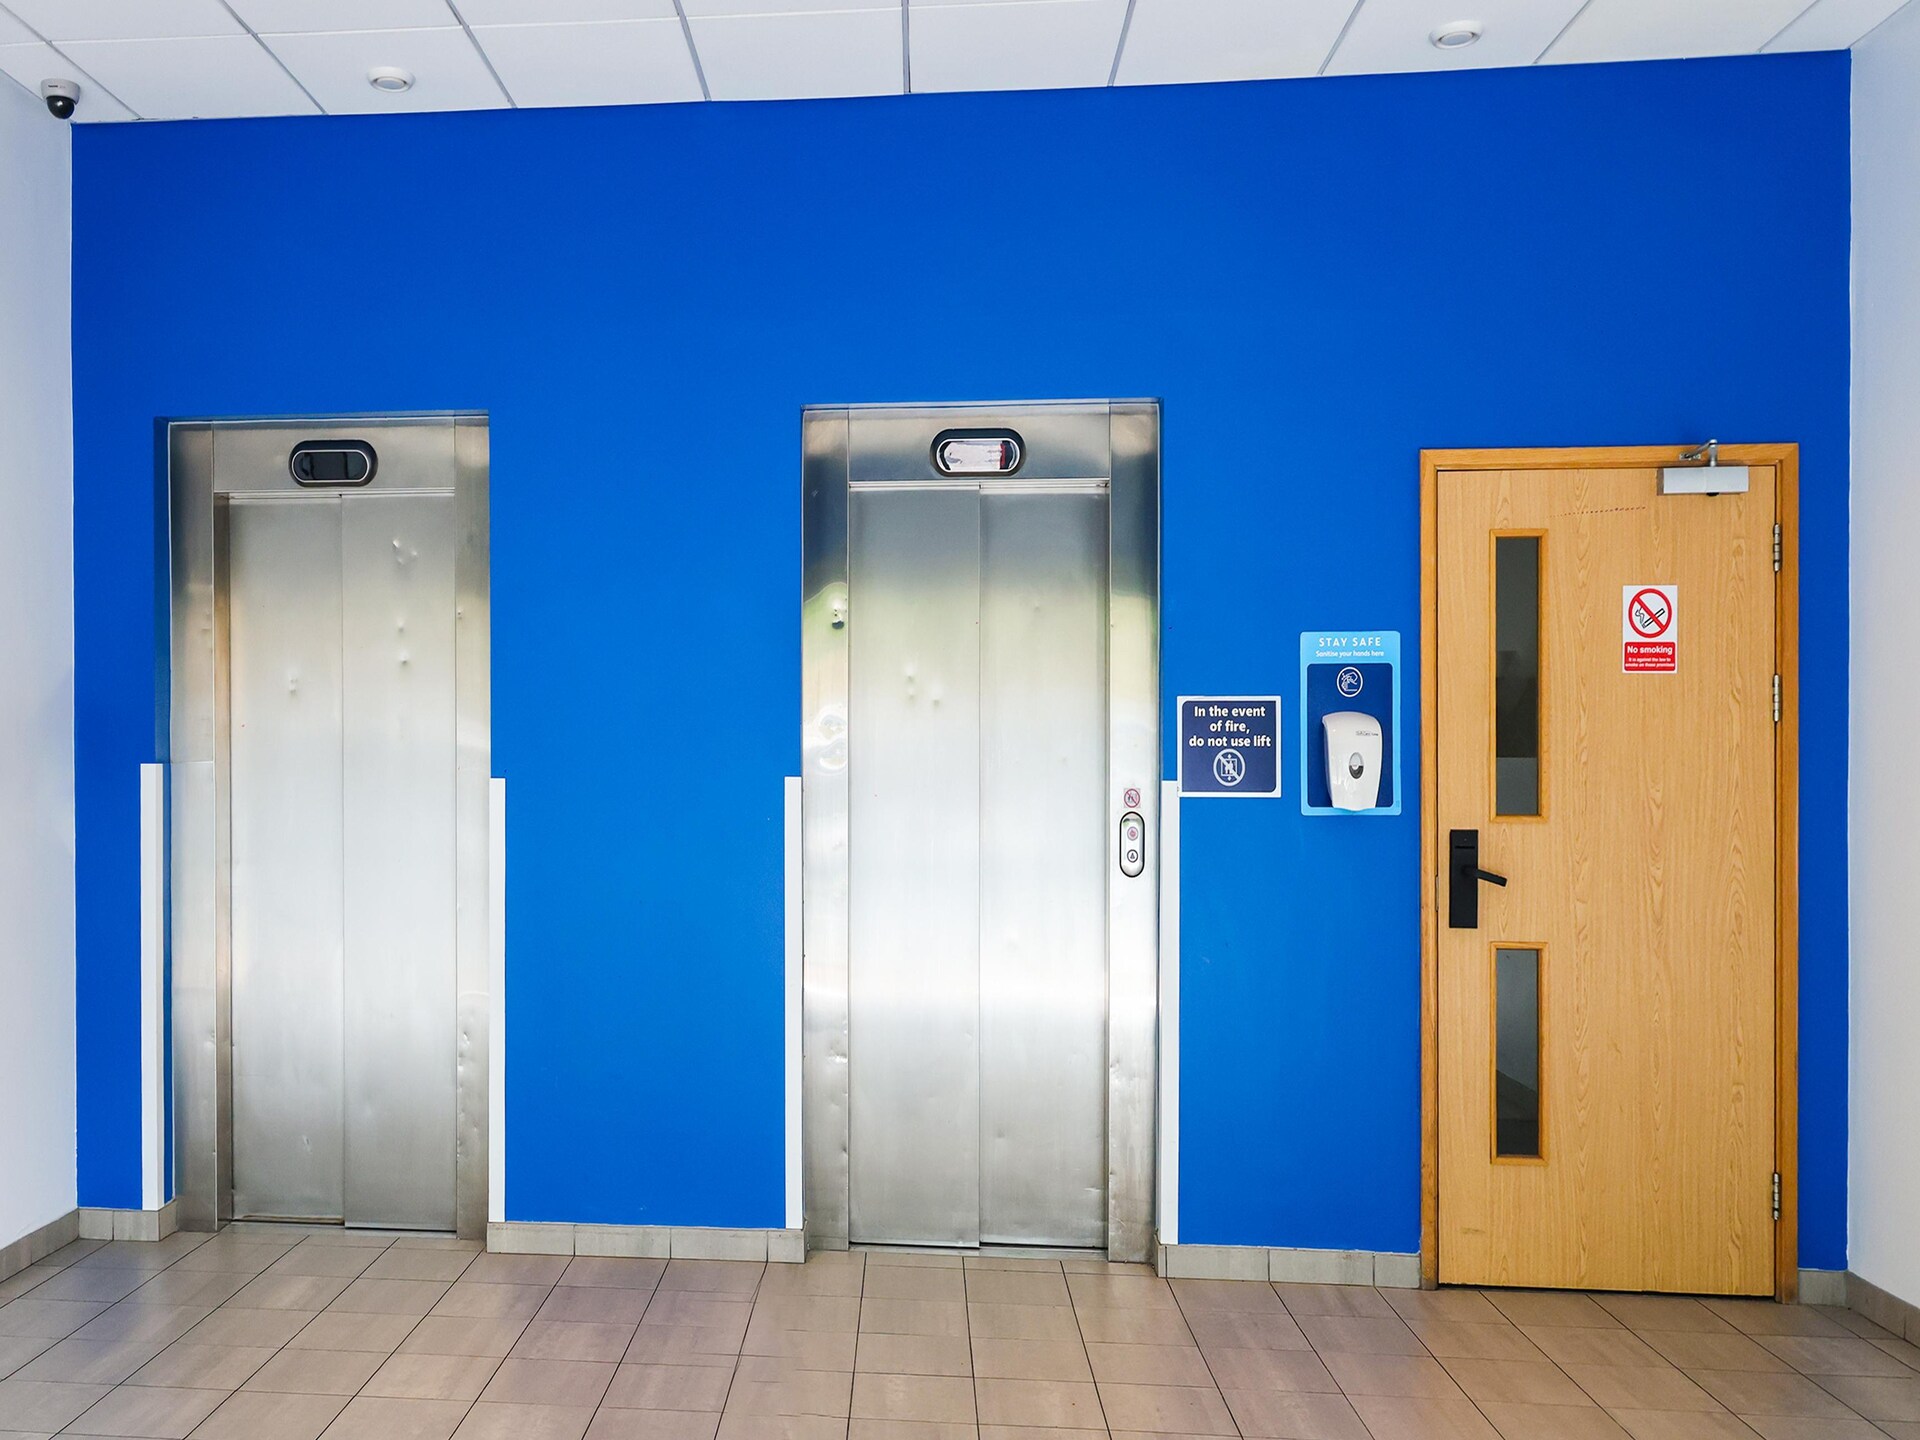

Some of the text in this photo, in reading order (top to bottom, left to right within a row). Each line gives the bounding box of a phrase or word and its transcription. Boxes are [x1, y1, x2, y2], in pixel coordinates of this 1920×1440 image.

[1319, 636, 1382, 647] STAY SAFE
[1627, 645, 1673, 656] No smoking
[1194, 704, 1266, 717] In the event
[1209, 720, 1250, 734] of fire,
[1188, 735, 1271, 747] do not use lift
